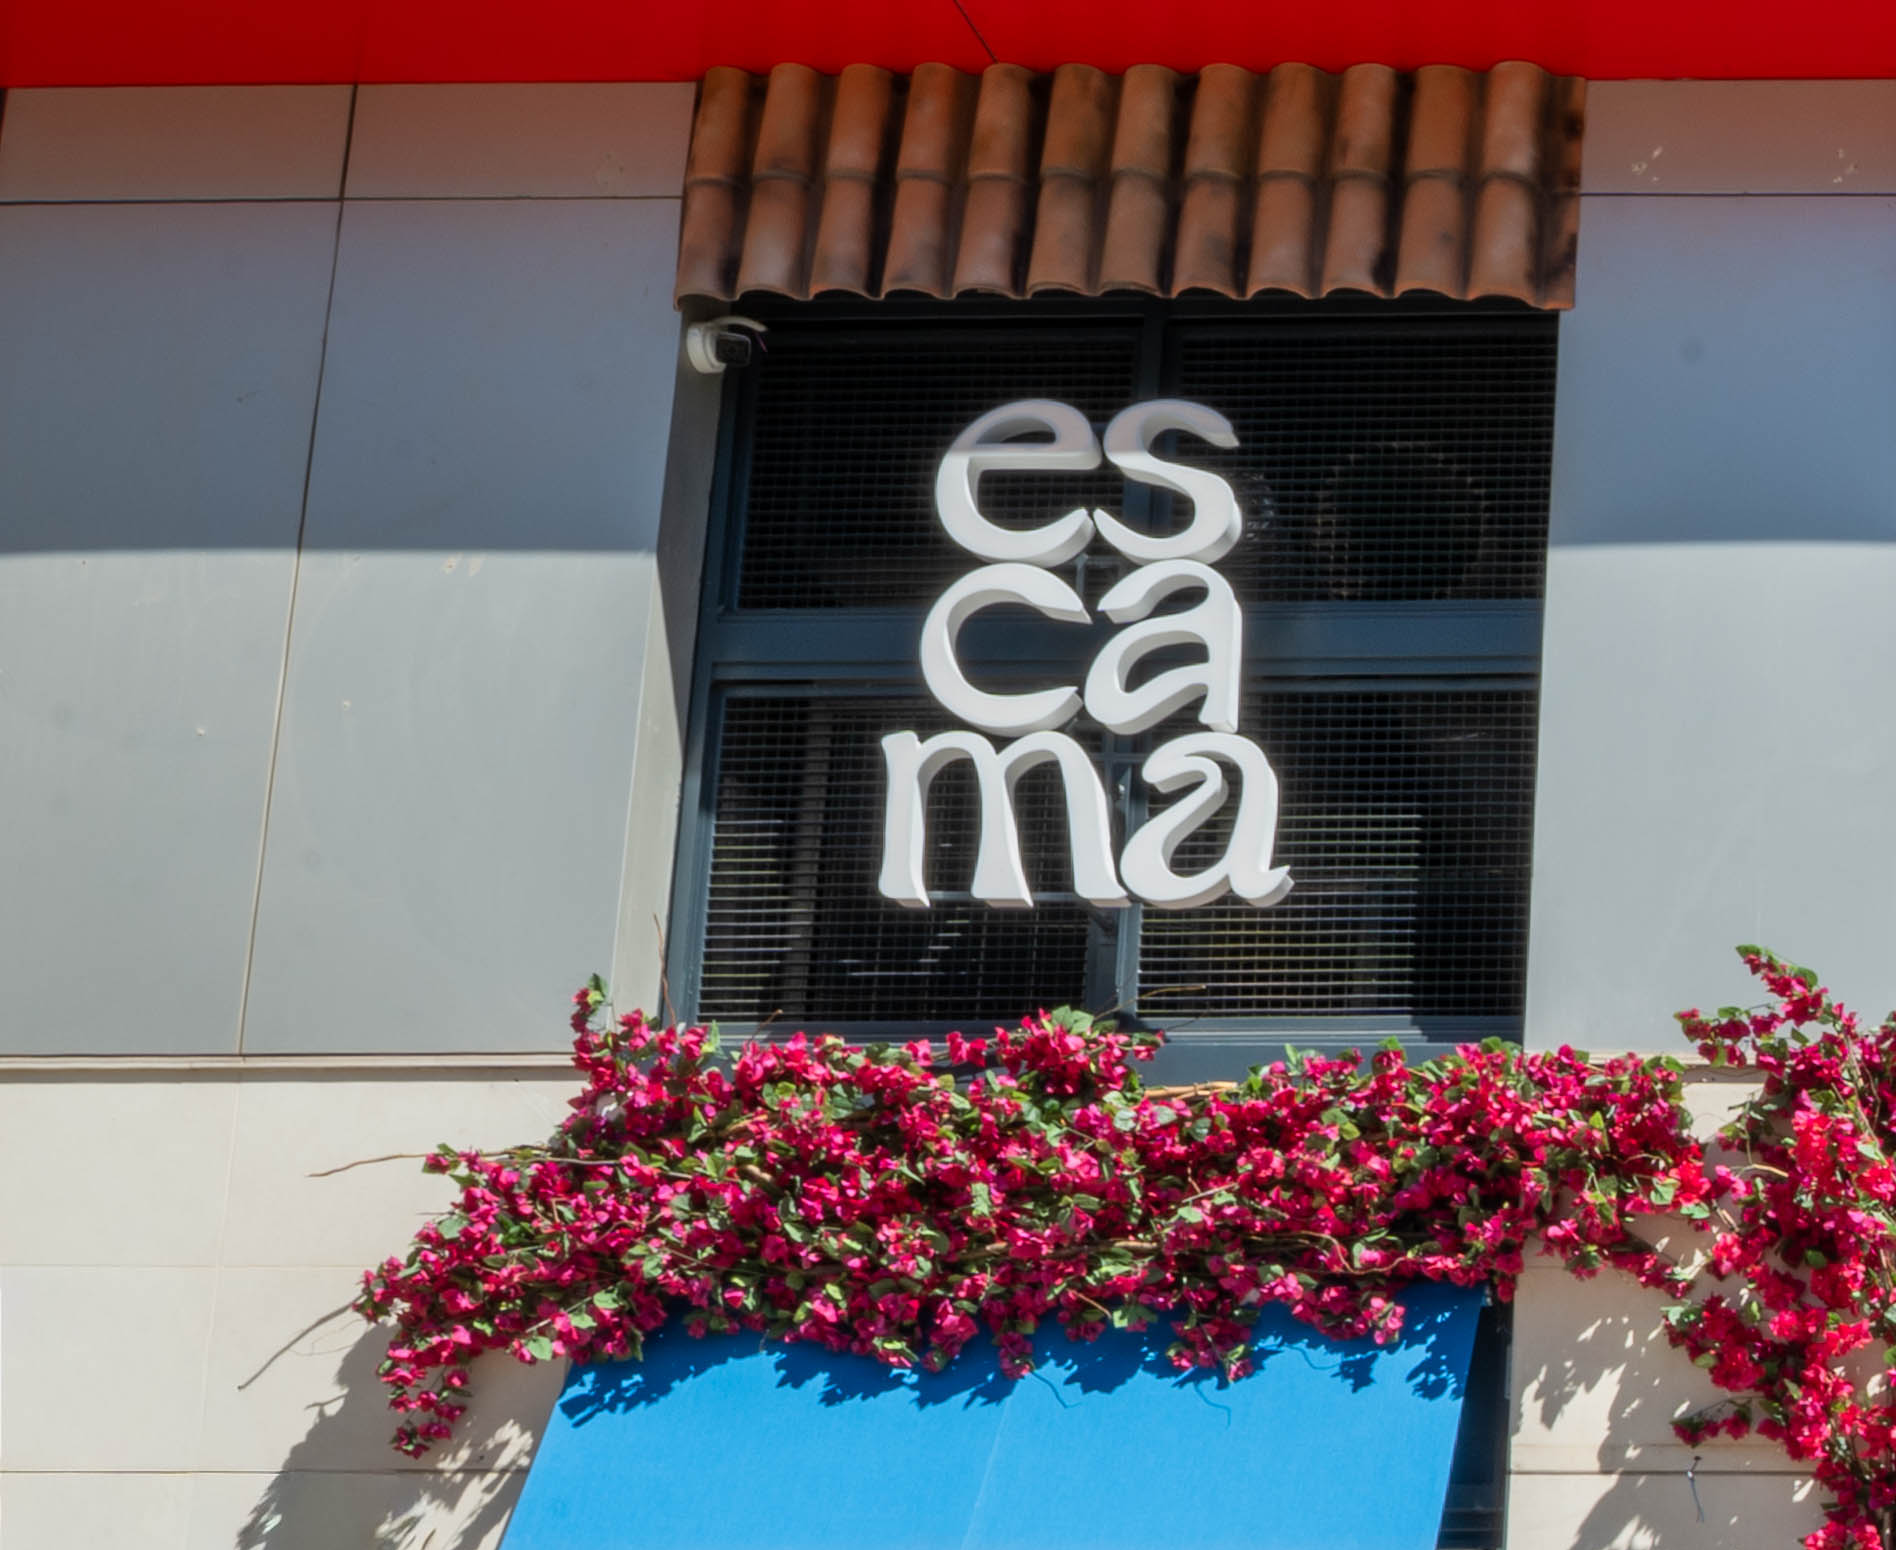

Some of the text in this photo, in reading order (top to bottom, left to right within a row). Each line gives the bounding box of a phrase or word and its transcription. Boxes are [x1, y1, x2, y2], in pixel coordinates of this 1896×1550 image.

[935, 398, 1242, 567] es
[919, 559, 1242, 737] ca
[878, 730, 1295, 909] ma
